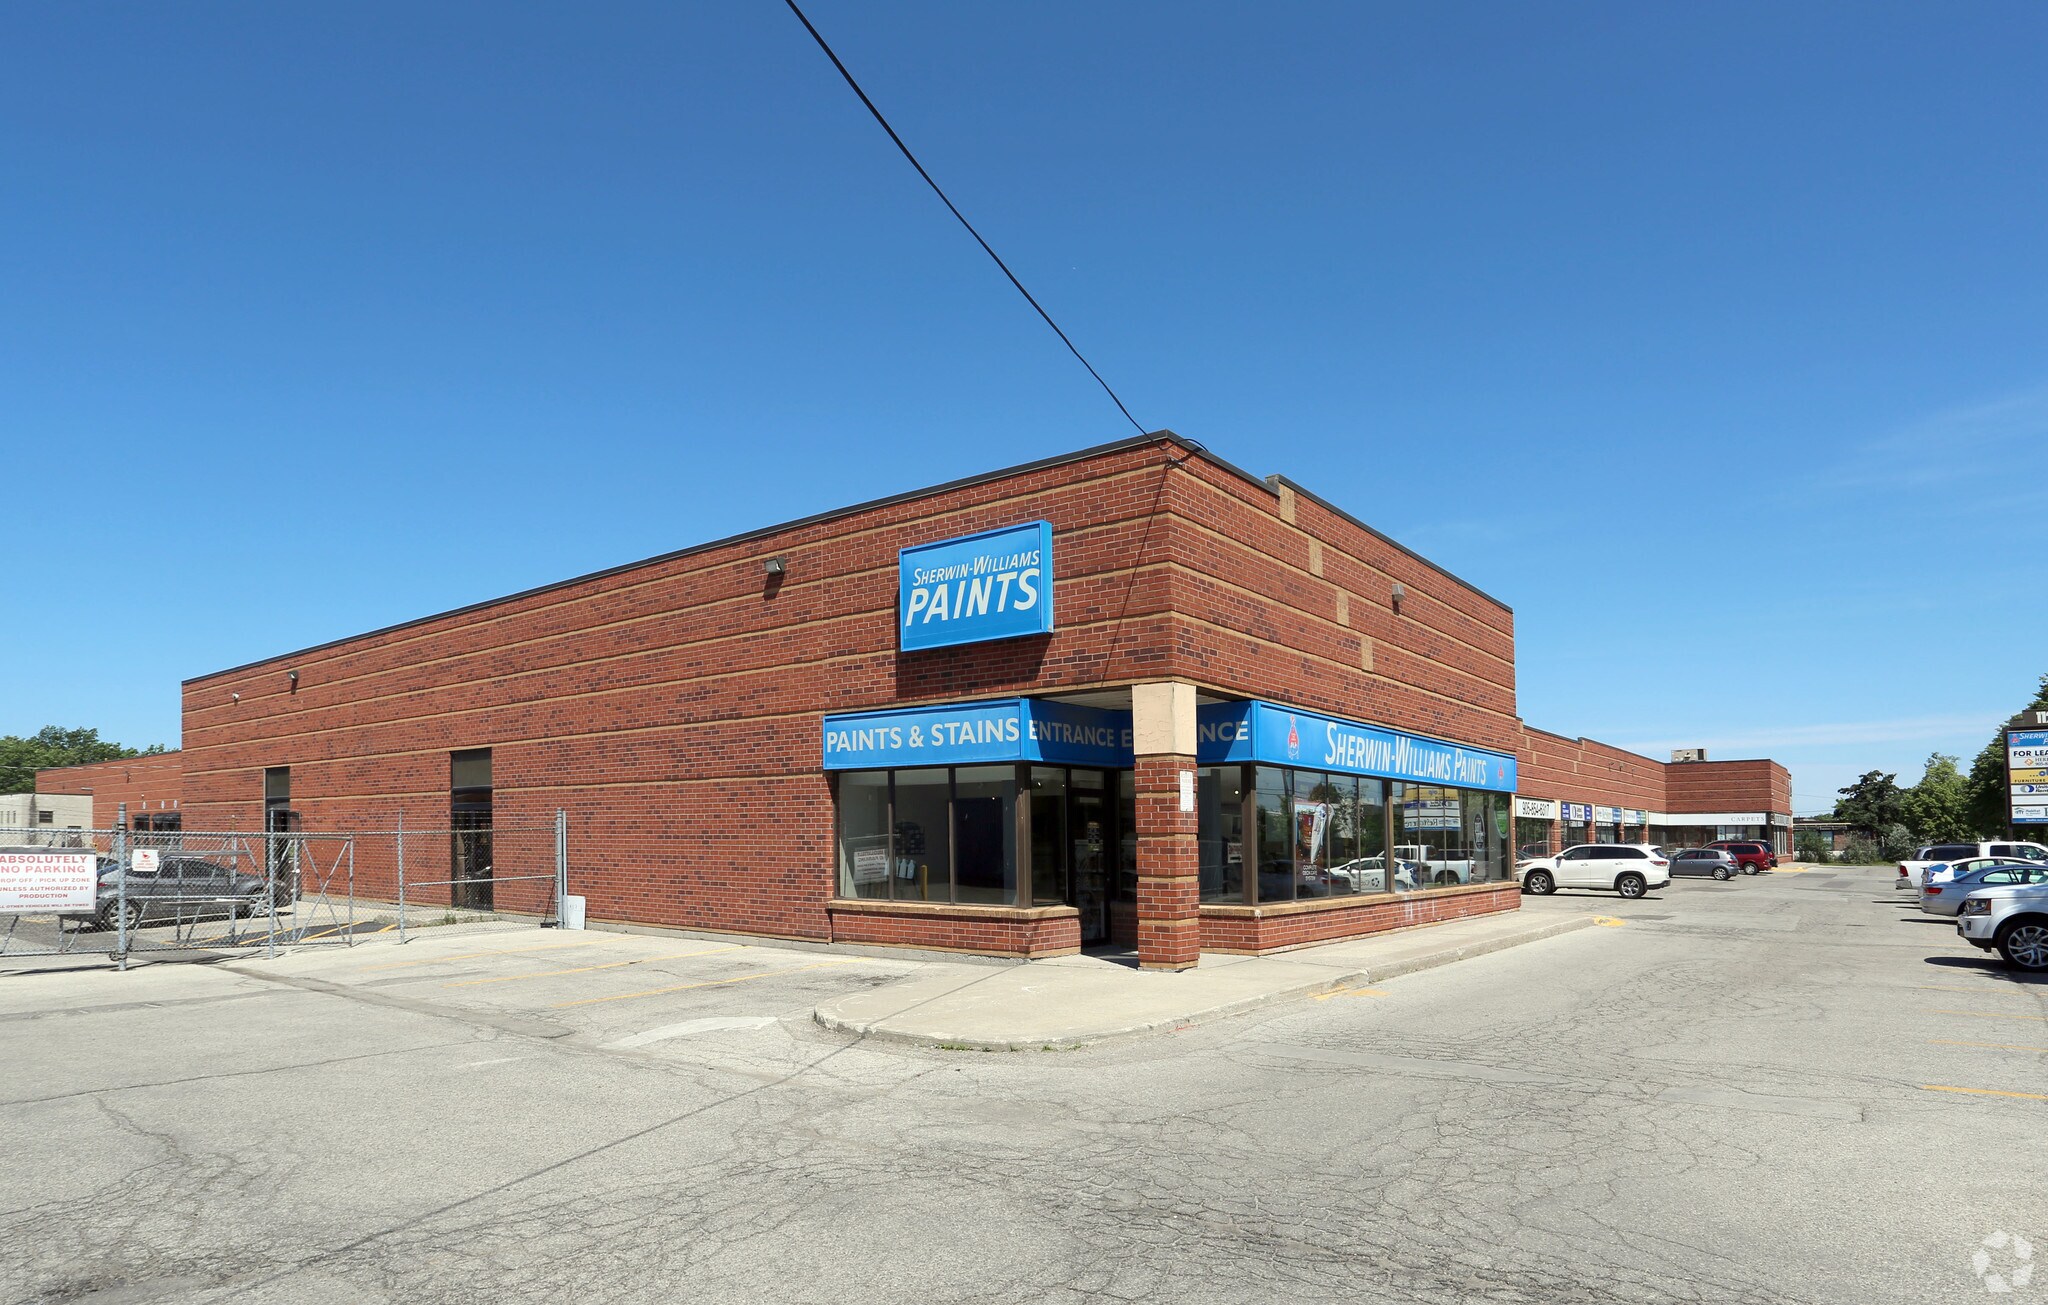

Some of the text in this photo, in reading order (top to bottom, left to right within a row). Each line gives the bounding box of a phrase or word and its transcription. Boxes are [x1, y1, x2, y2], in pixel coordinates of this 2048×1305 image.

[913, 550, 1040, 586] SHERWIN-WILLIAMS
[905, 568, 1041, 627] PAINTS
[827, 717, 1020, 753] PAINTS & STAINS
[1029, 720, 1115, 748] ENTRANCE
[1325, 721, 1487, 786] SHERWIN-WILLIAMS PAINTS
[1, 865, 86, 873] NO PARKING
